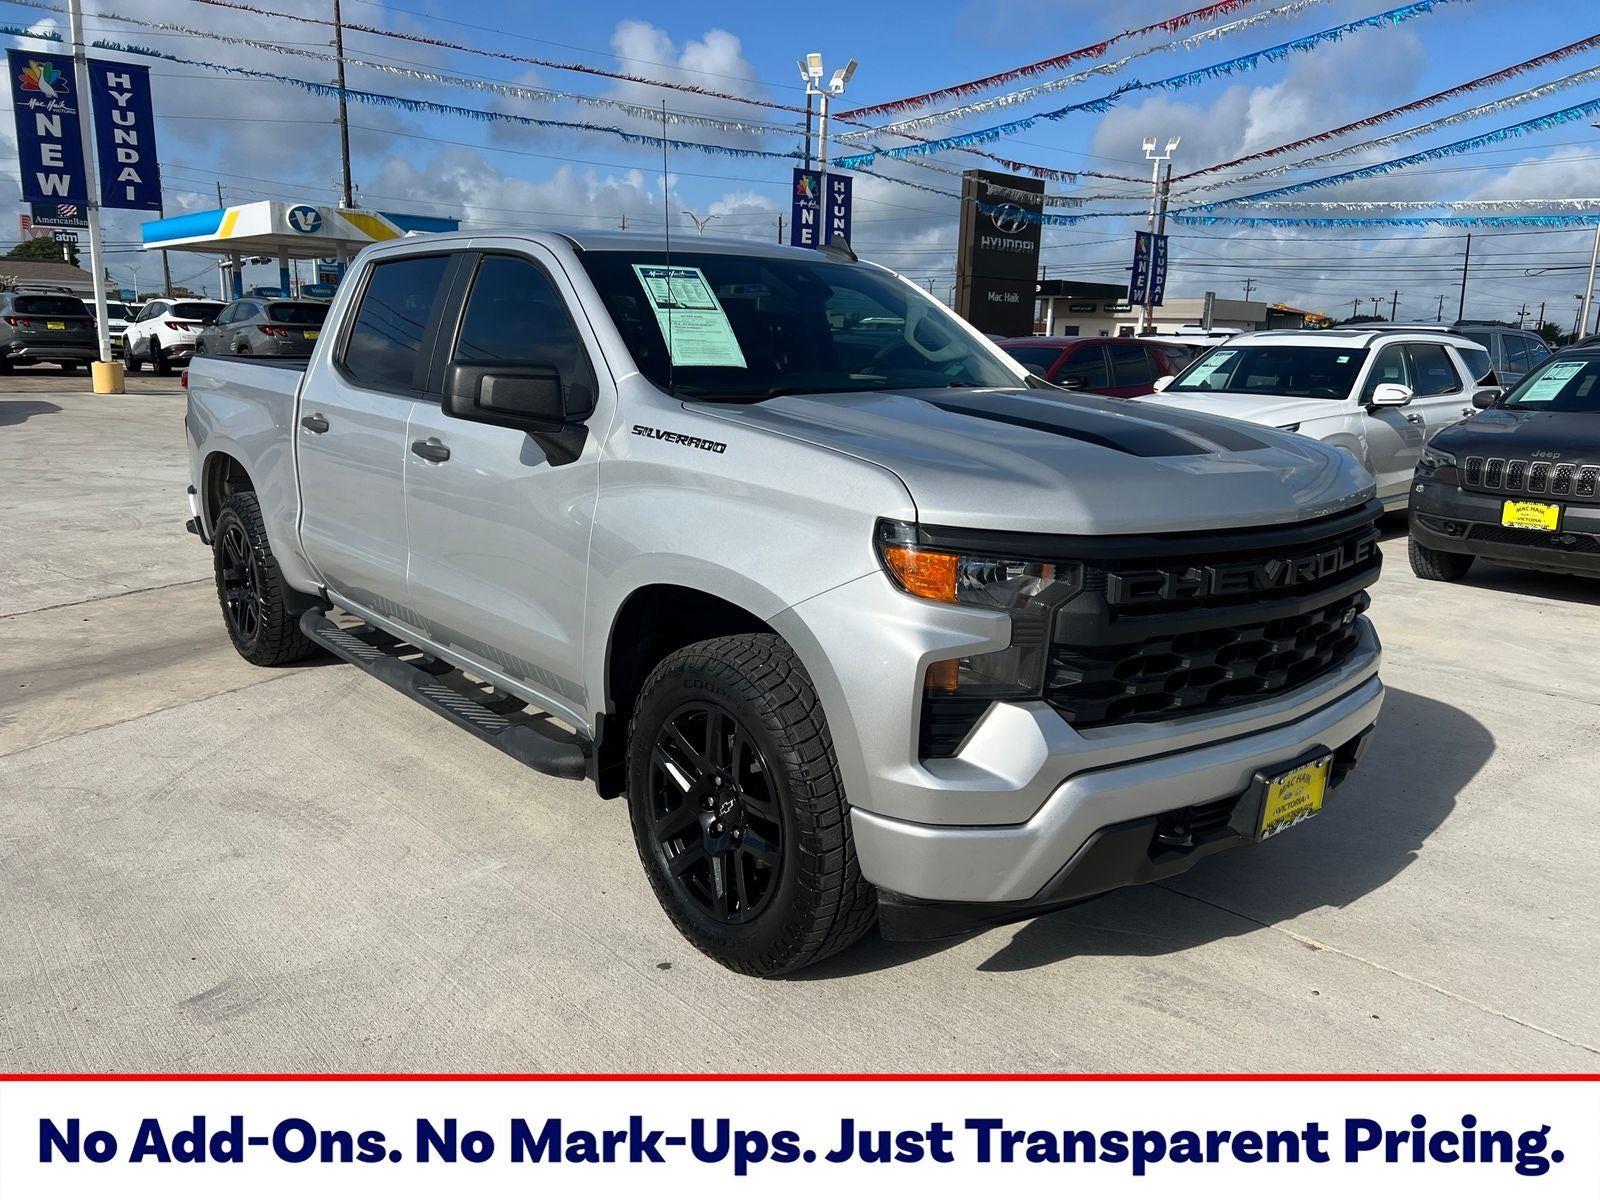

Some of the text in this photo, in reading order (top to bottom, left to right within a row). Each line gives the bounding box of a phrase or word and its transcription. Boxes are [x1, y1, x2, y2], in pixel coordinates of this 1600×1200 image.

[22, 97, 71, 111] Mac Haik
[106, 71, 142, 201] HYUNDAI
[35, 113, 71, 197] NEW
[35, 216, 88, 226] AmericanBan
[833, 181, 845, 237] HYUN
[55, 233, 78, 242] atm
[981, 236, 1034, 250] HYUNDAI
[1133, 261, 1146, 302] NEW
[1154, 239, 1165, 302] HYUNDAI
[987, 291, 1020, 303] Mac Haik
[631, 424, 727, 454] SILVERADO
[1531, 449, 1561, 459] Jeep
[1530, 506, 1546, 515] HAIK
[1105, 529, 1381, 604] CHEVROLET
[1278, 775, 1296, 798] MAC
[1295, 772, 1311, 785] HAIK
[1273, 793, 1310, 816] VICTORIA
